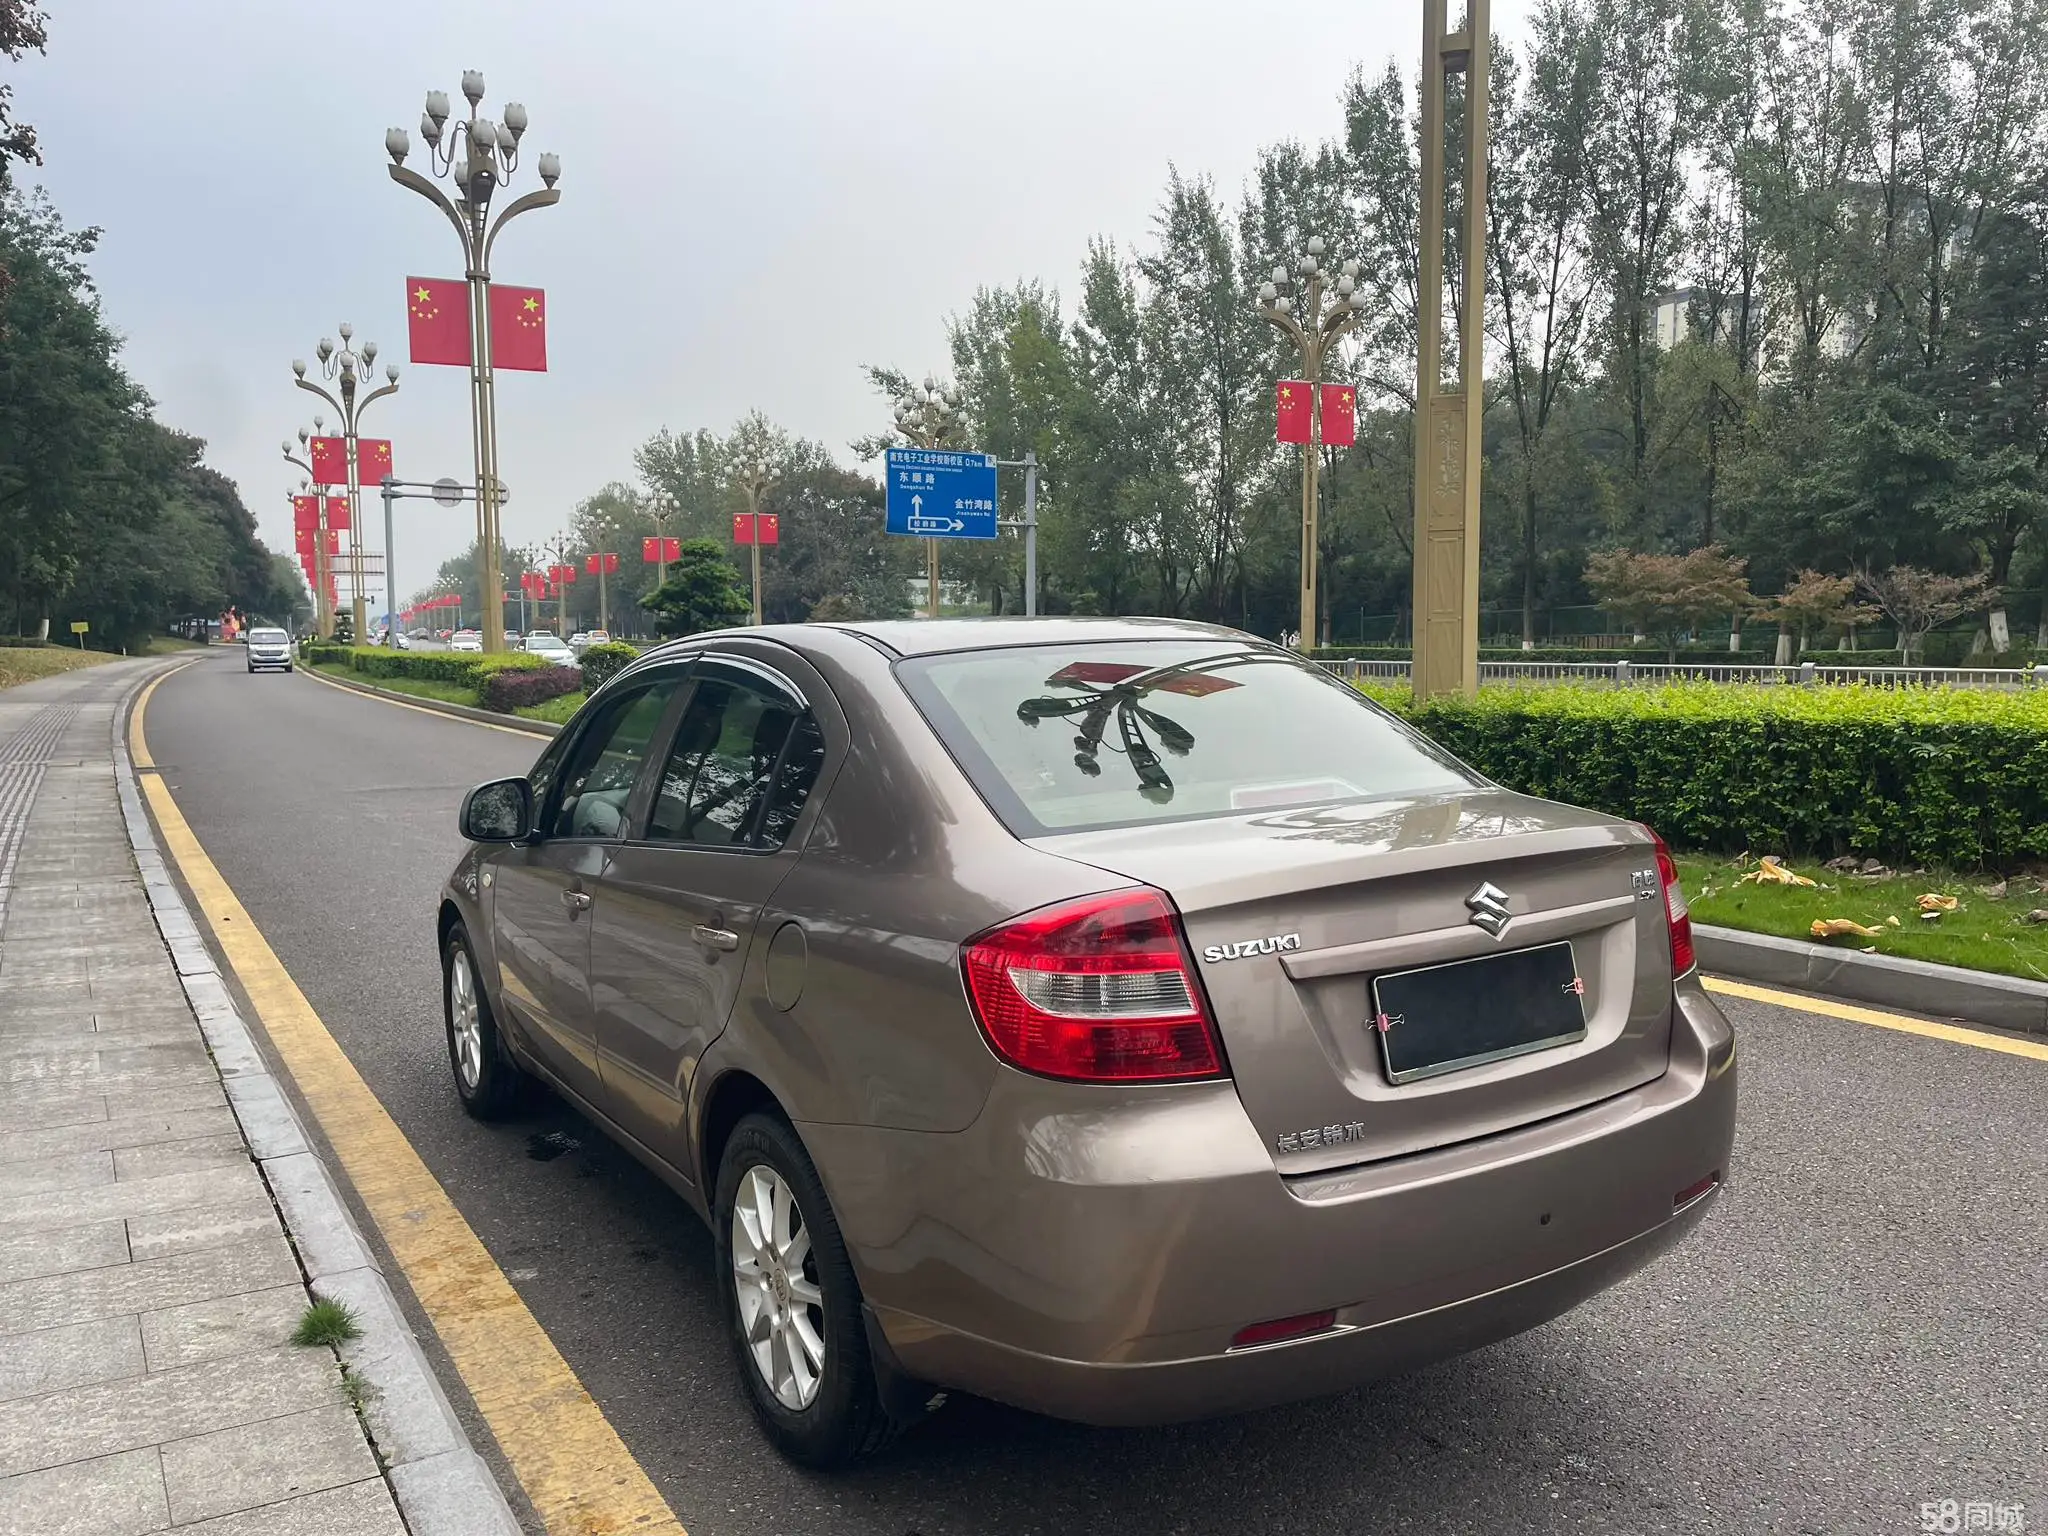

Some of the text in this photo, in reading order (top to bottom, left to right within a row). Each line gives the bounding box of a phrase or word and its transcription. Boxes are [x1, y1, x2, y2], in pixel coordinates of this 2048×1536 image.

[954, 498, 993, 510] 金竹湾路
[1203, 932, 1302, 964] SUZUKI
[1277, 1120, 1366, 1154] 长安铃木
